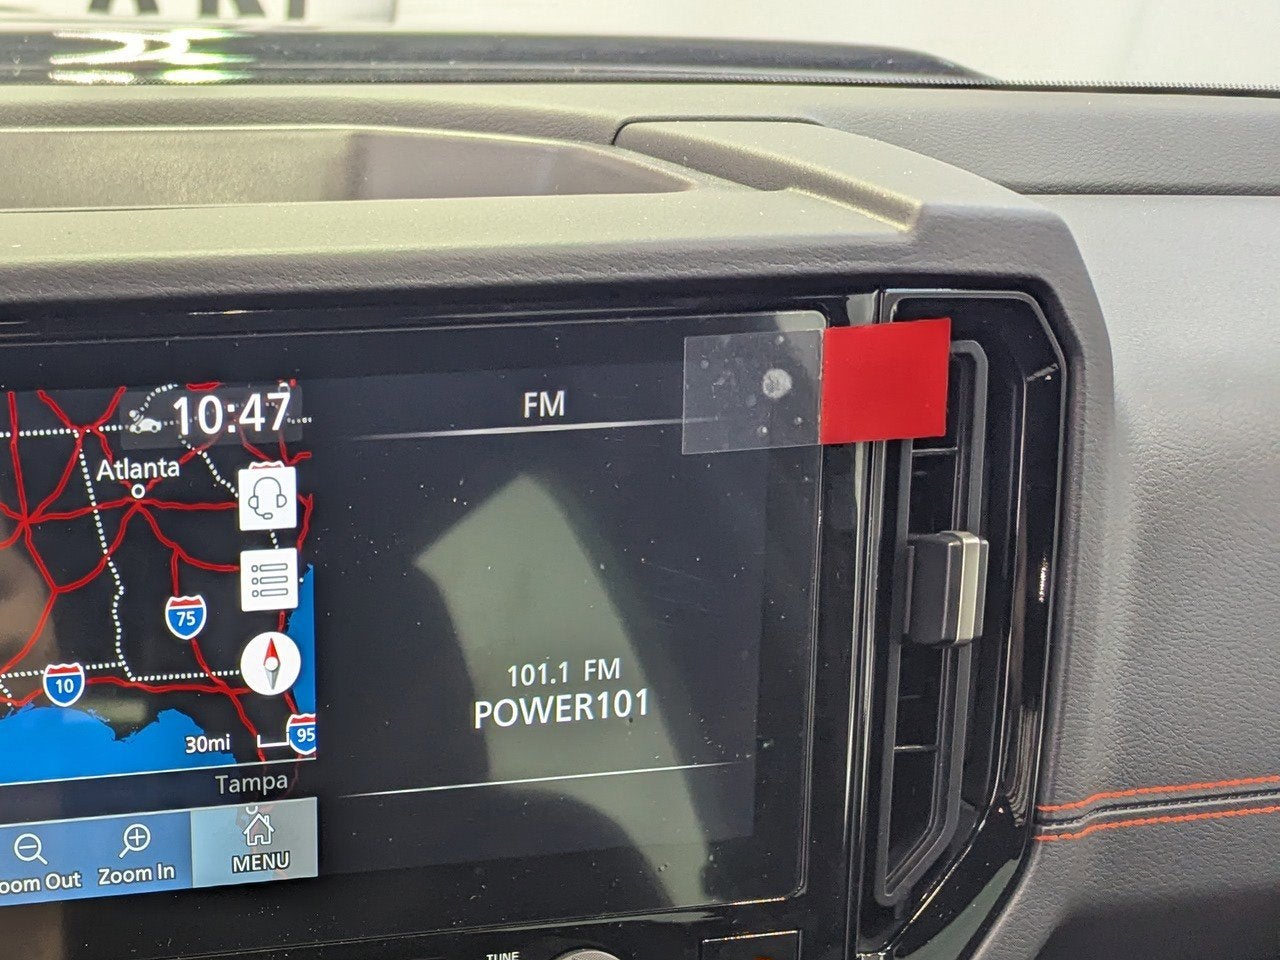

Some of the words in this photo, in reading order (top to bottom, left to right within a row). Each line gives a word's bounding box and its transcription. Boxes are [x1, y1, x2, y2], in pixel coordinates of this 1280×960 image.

[173, 392, 291, 436] 10:47
[524, 390, 565, 418] FM
[96, 456, 180, 481] Atlanta
[176, 610, 196, 627] 75
[507, 661, 570, 688] 101.1
[584, 657, 621, 682] FM
[56, 679, 74, 694] 10
[474, 688, 649, 730] POWER101
[185, 735, 231, 754] 30mi
[296, 727, 316, 743] 95
[215, 773, 289, 795] Tampa
[98, 866, 152, 886] Zoom
[157, 863, 176, 880] In
[232, 851, 291, 875] MENU
[45, 871, 82, 891] Out
